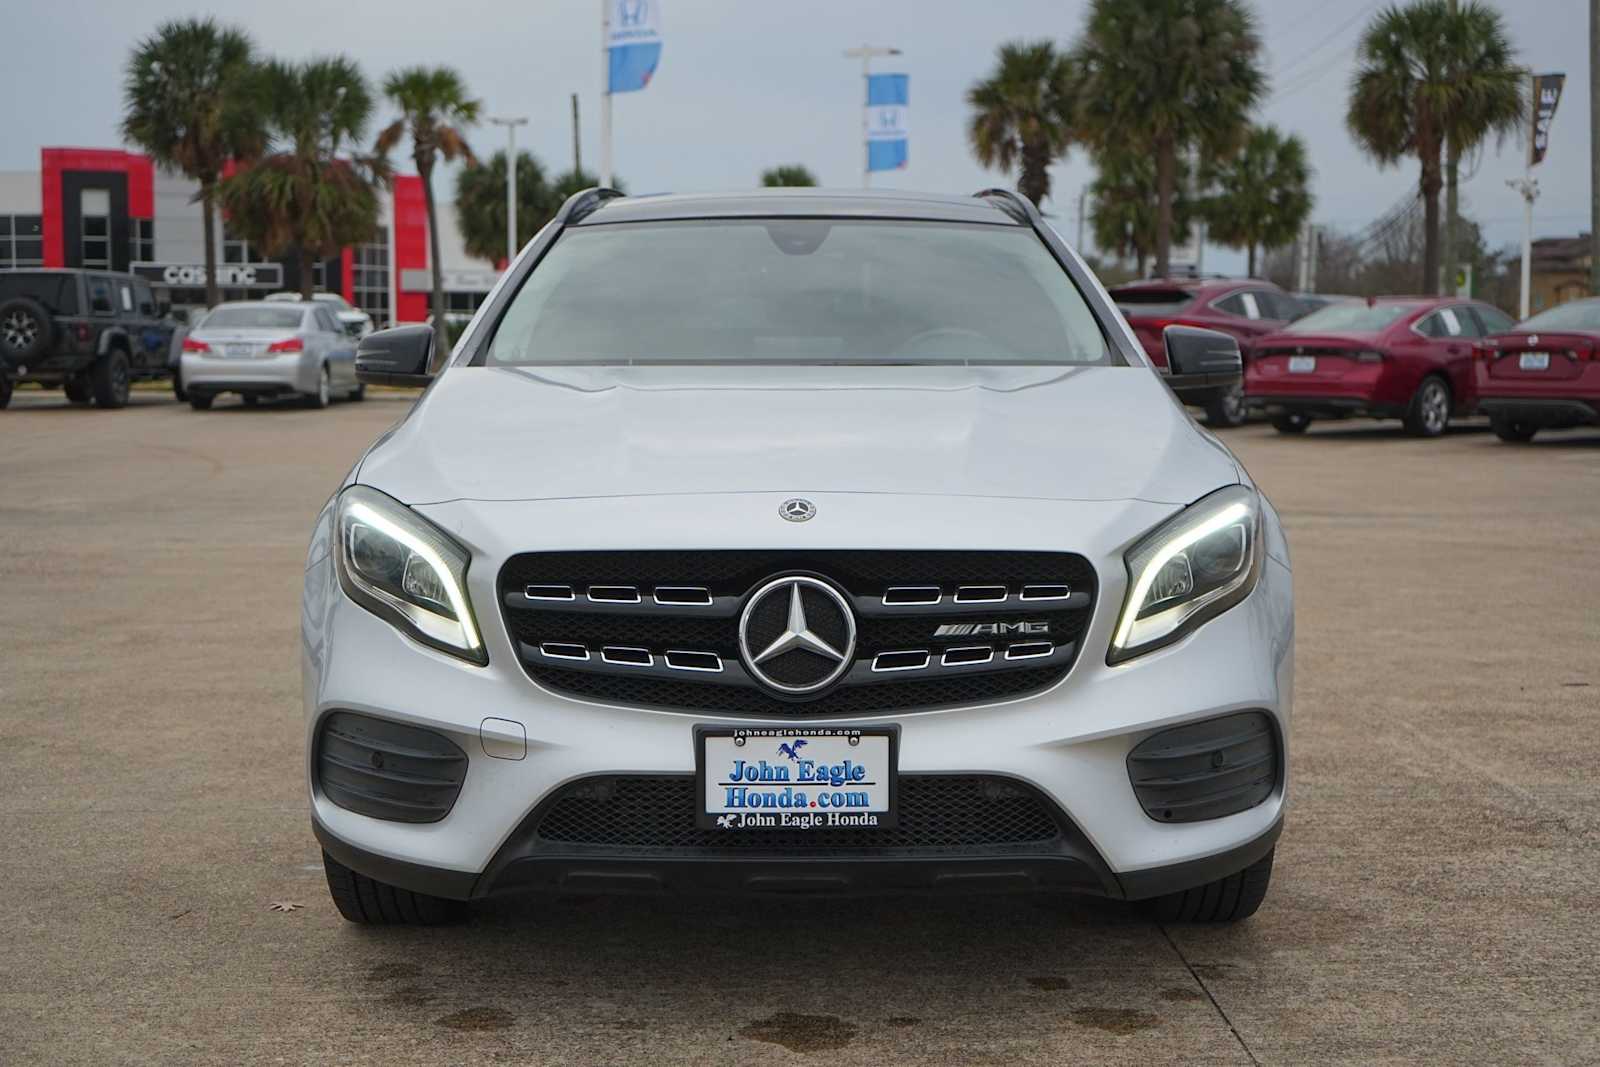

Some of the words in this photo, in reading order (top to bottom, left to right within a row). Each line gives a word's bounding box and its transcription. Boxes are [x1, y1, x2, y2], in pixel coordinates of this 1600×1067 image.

[734, 728, 861, 737] johneaglehonda.com
[729, 760, 790, 782] John
[797, 760, 866, 787] Eagle
[724, 787, 870, 808] Honda.com
[737, 813, 776, 828] John
[780, 813, 823, 829] Eagle
[827, 812, 878, 826] Honda
